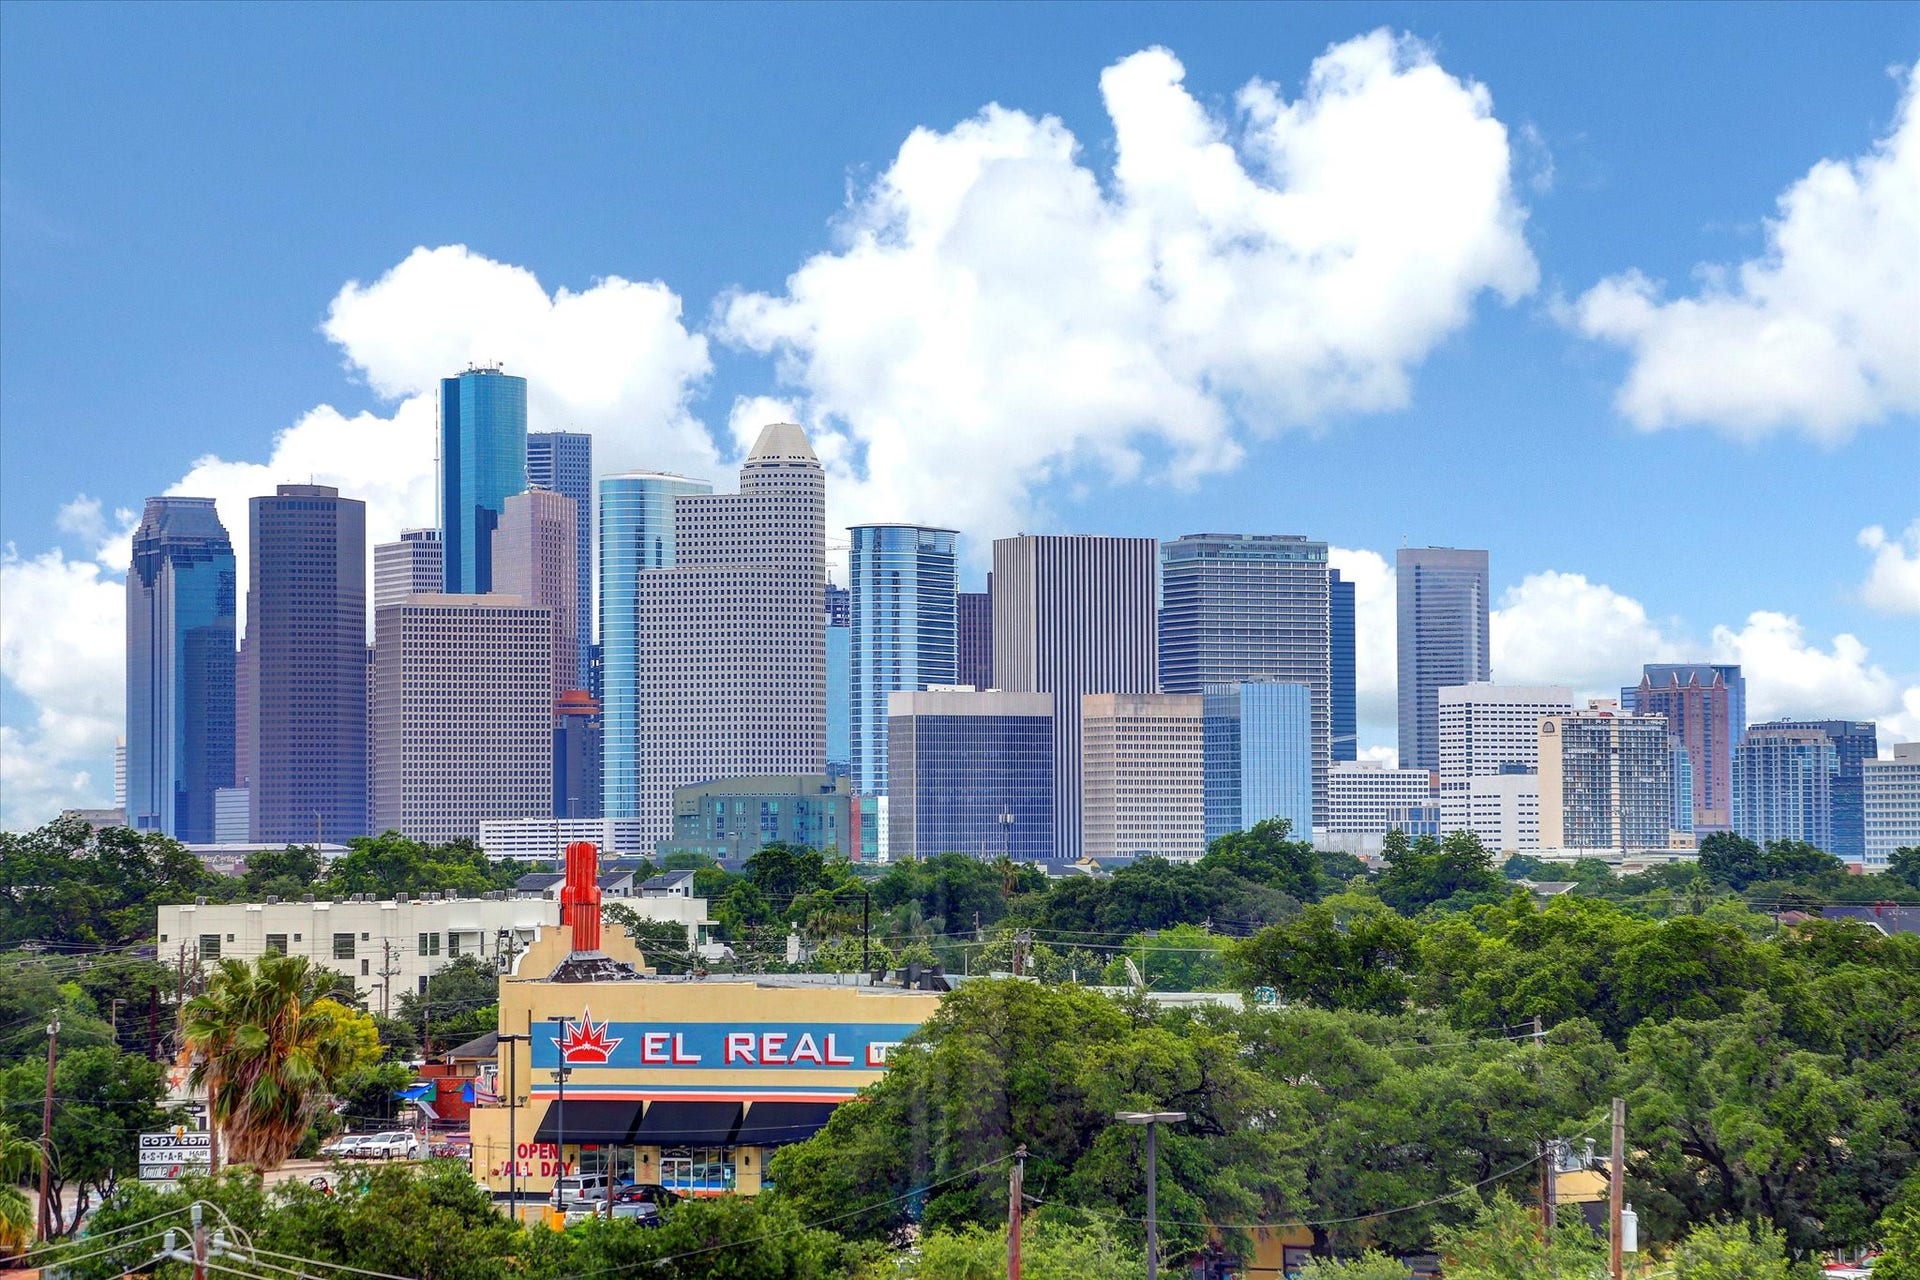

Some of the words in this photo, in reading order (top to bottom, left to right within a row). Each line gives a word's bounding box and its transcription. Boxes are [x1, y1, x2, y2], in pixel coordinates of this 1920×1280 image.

[641, 1032, 702, 1064] EL
[725, 1032, 854, 1065] REAL
[142, 1136, 209, 1147] copy.com
[517, 1143, 559, 1159] OPEN
[141, 1166, 168, 1179] Smoke
[503, 1161, 533, 1177] ALL
[541, 1161, 572, 1177] DAY
